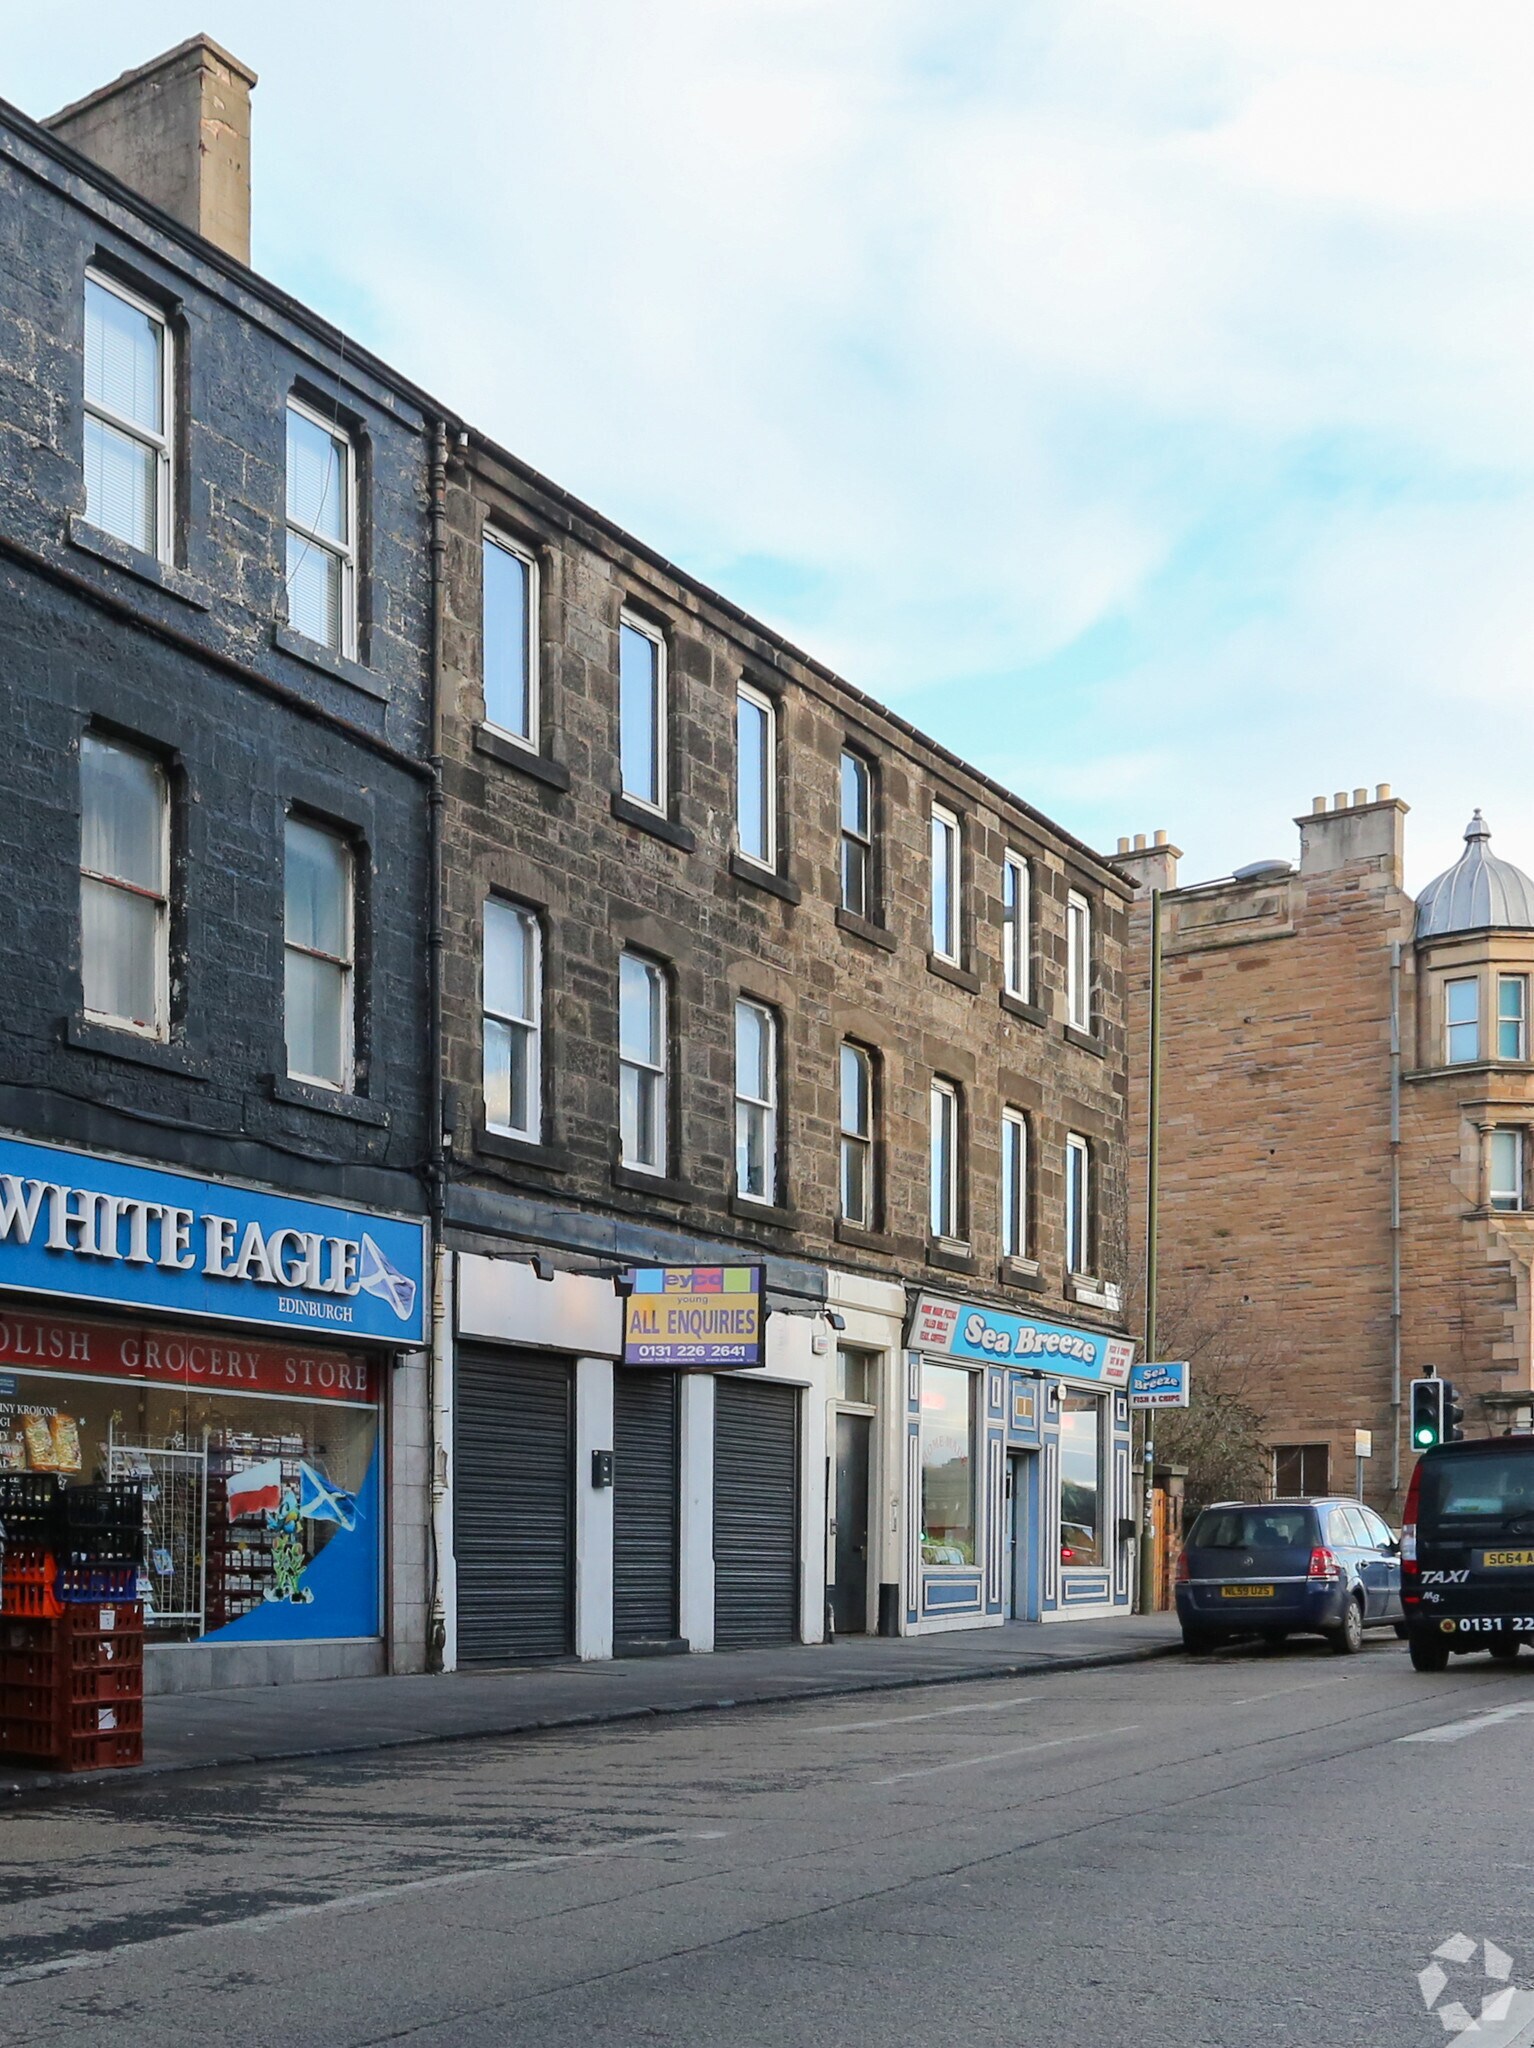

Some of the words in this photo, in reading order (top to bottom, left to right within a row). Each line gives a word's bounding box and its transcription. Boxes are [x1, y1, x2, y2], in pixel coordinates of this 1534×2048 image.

[0, 1173, 196, 1271] WHITE
[201, 1214, 361, 1296] EAGLE
[677, 1296, 708, 1305] young
[278, 1296, 353, 1323] EDINBURGH
[630, 1310, 660, 1334] ALL
[667, 1309, 755, 1340] ENQUIRIES
[964, 1314, 1011, 1354] Sea
[1013, 1327, 1096, 1364] Breeze
[639, 1345, 671, 1357] 0131
[677, 1345, 705, 1357] 226
[711, 1345, 745, 1357] 2641
[120, 1338, 260, 1380] GROCERY
[285, 1357, 368, 1391] STORE
[1143, 1367, 1167, 1381] Sea
[1134, 1377, 1179, 1391] Breeze
[17, 1404, 58, 1416] KROJONE
[1489, 1552, 1522, 1564] SC64
[1421, 1570, 1469, 1584] TAXI
[1459, 1618, 1502, 1632] 0131
